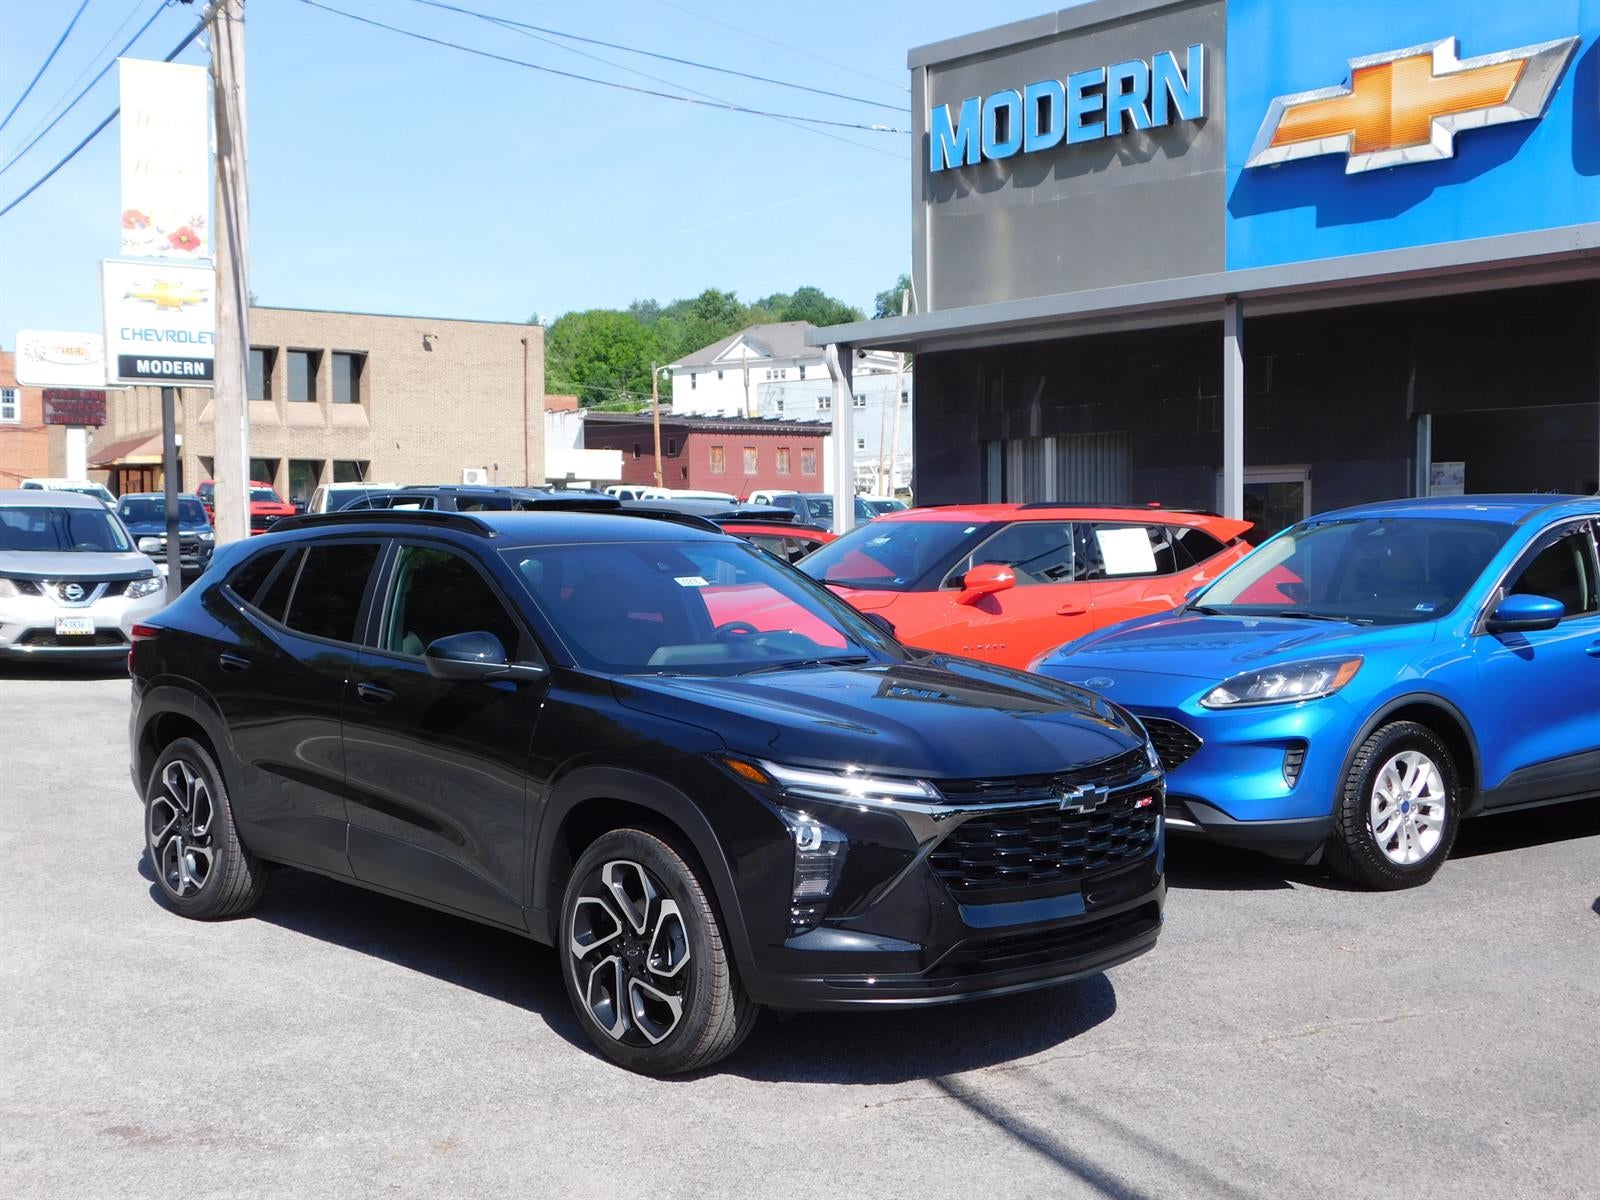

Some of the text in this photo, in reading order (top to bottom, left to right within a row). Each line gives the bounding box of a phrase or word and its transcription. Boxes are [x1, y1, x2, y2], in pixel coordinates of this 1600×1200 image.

[930, 43, 1204, 173] MODERN
[120, 327, 216, 345] CHEVROLET
[136, 359, 205, 376] MODERN
